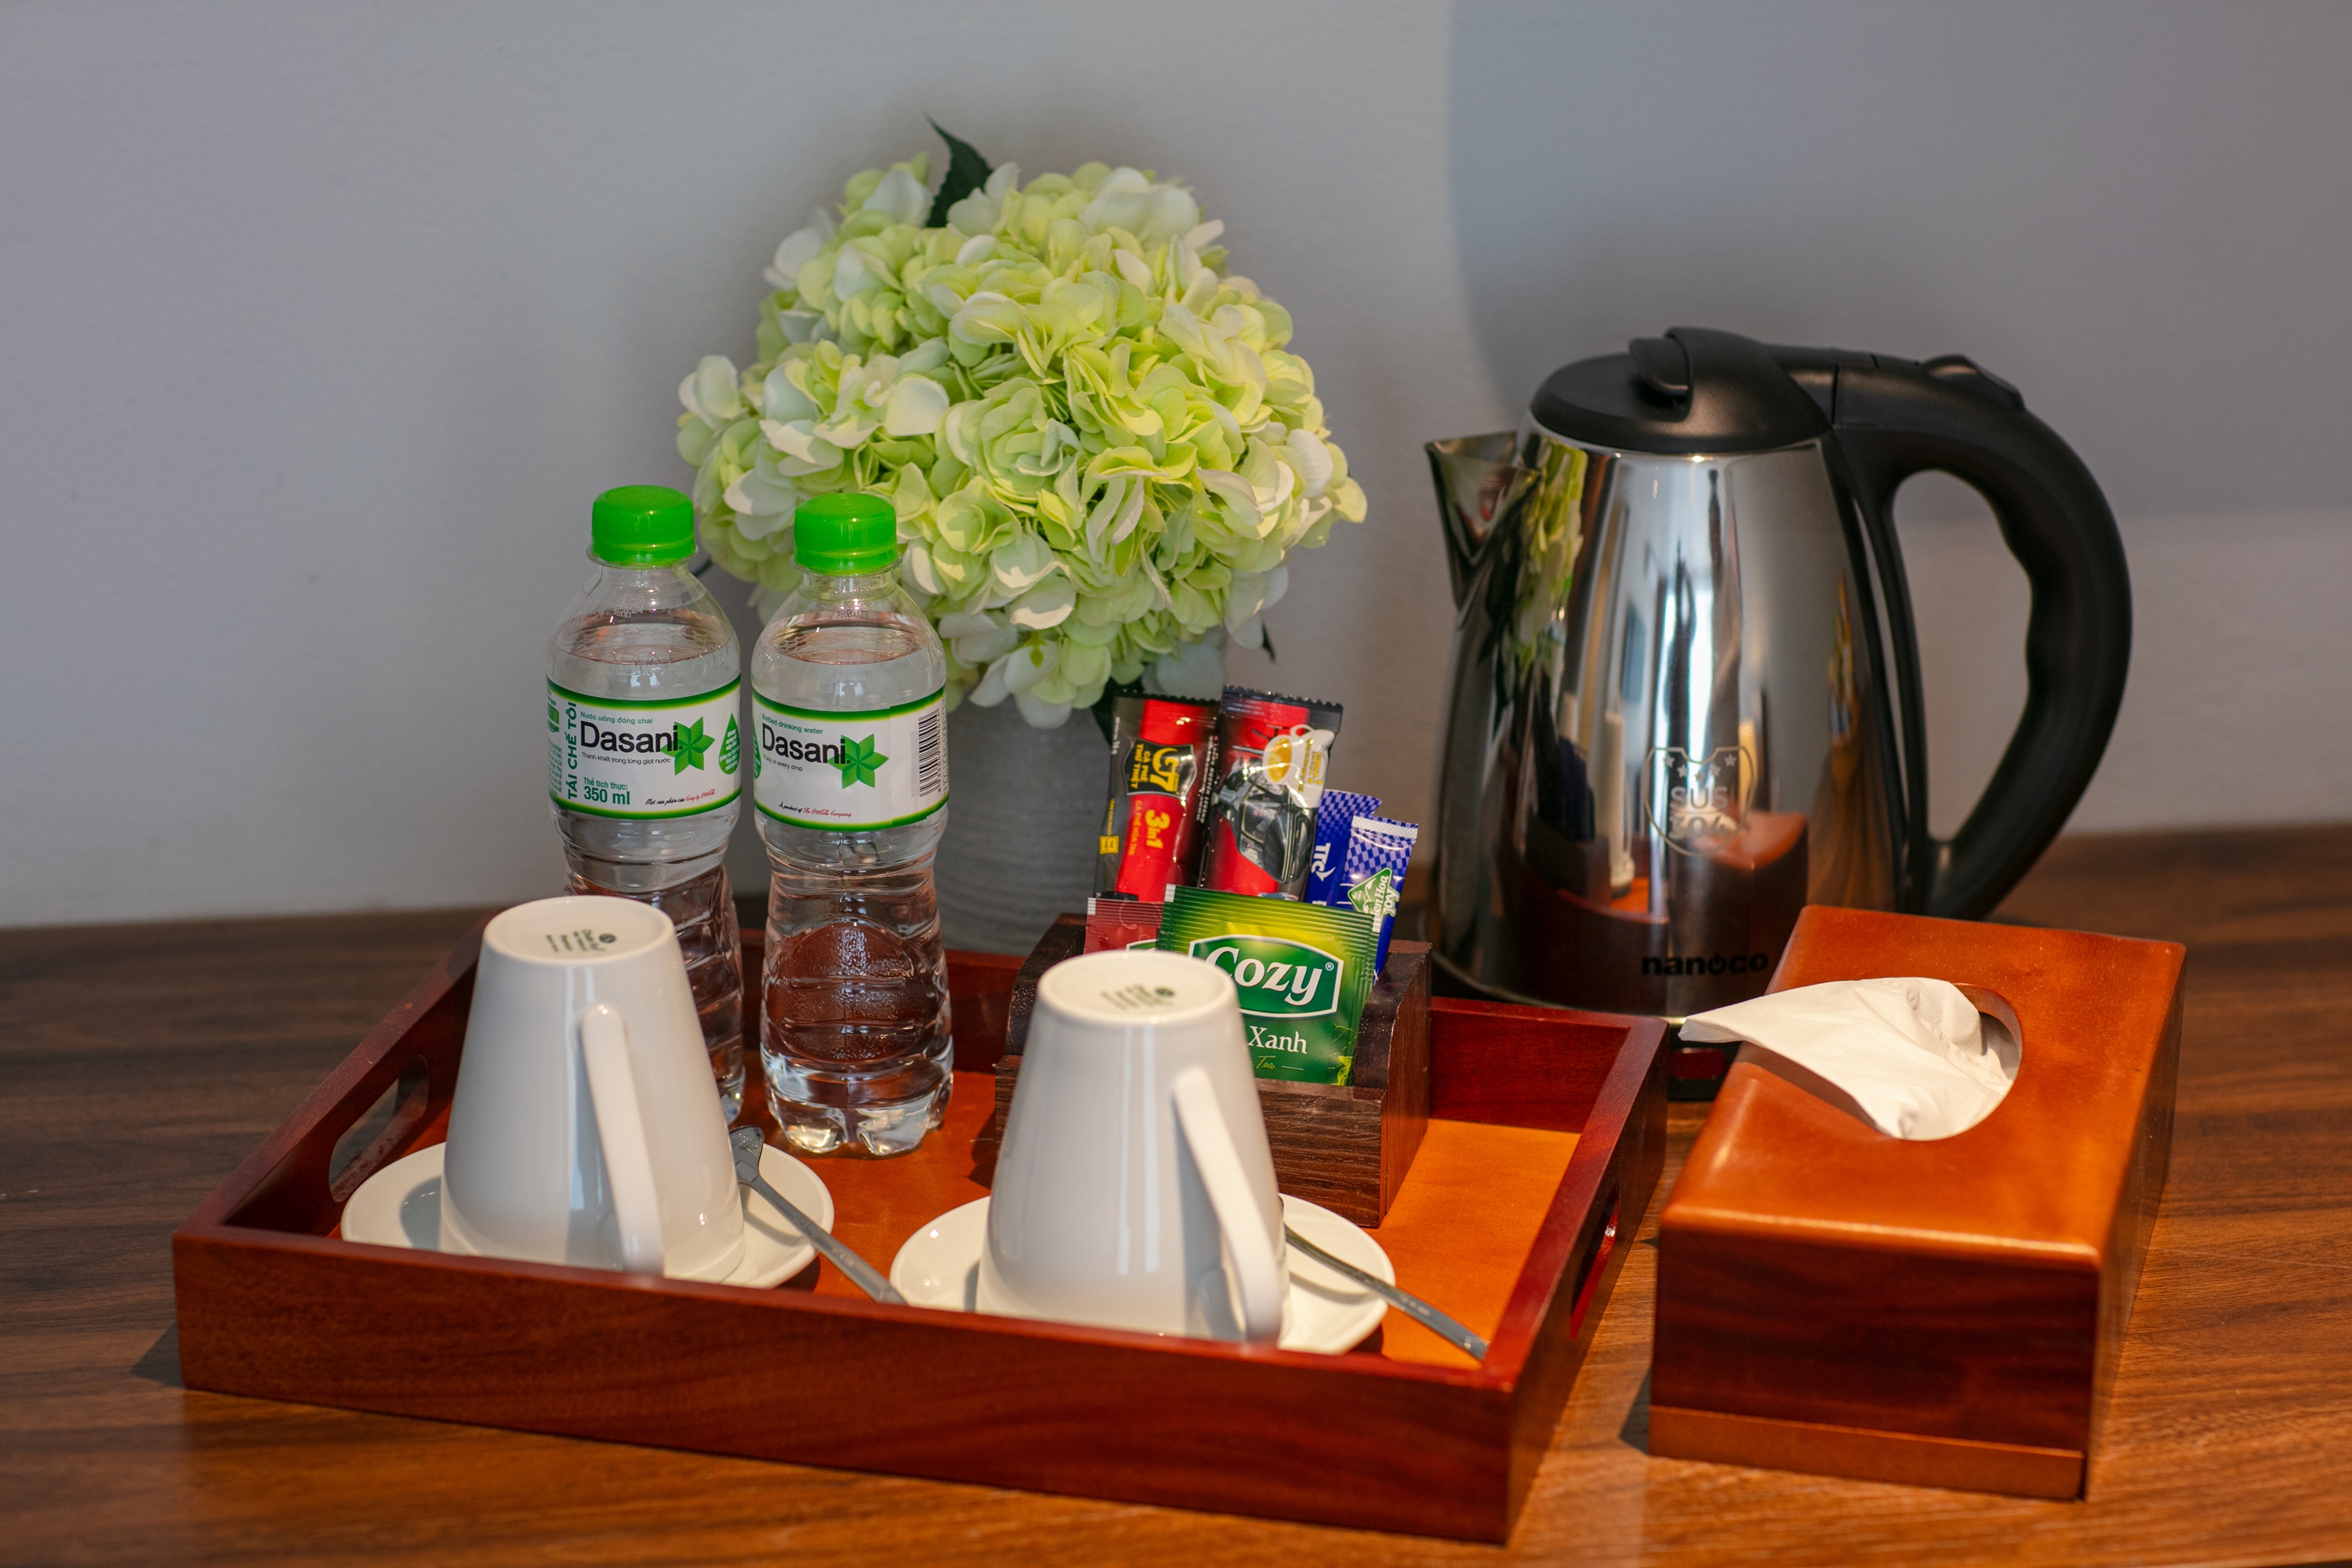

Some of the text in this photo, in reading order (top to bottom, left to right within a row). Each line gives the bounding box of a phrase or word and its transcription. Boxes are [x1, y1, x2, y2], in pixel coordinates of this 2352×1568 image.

[580, 720, 678, 753] Dasani
[779, 720, 802, 733] drinking
[564, 702, 578, 800] TÁI CHẾ TÔI
[762, 722, 846, 764] Dasani
[581, 751, 597, 760] Thanh
[777, 760, 790, 769] every
[583, 786, 630, 805] 350 ml
[596, 780, 608, 789] tích
[1670, 786, 1729, 810] SUS
[1145, 809, 1171, 849] 3in1
[1669, 816, 1728, 840] 304
[1311, 843, 1331, 873] TTC
[1374, 875, 1388, 900] Hoa
[1642, 953, 1769, 975] nanoco
[1204, 946, 1323, 1007] Cozy
[1247, 1025, 1308, 1054] Xanh
[1256, 1055, 1276, 1070] Tea
